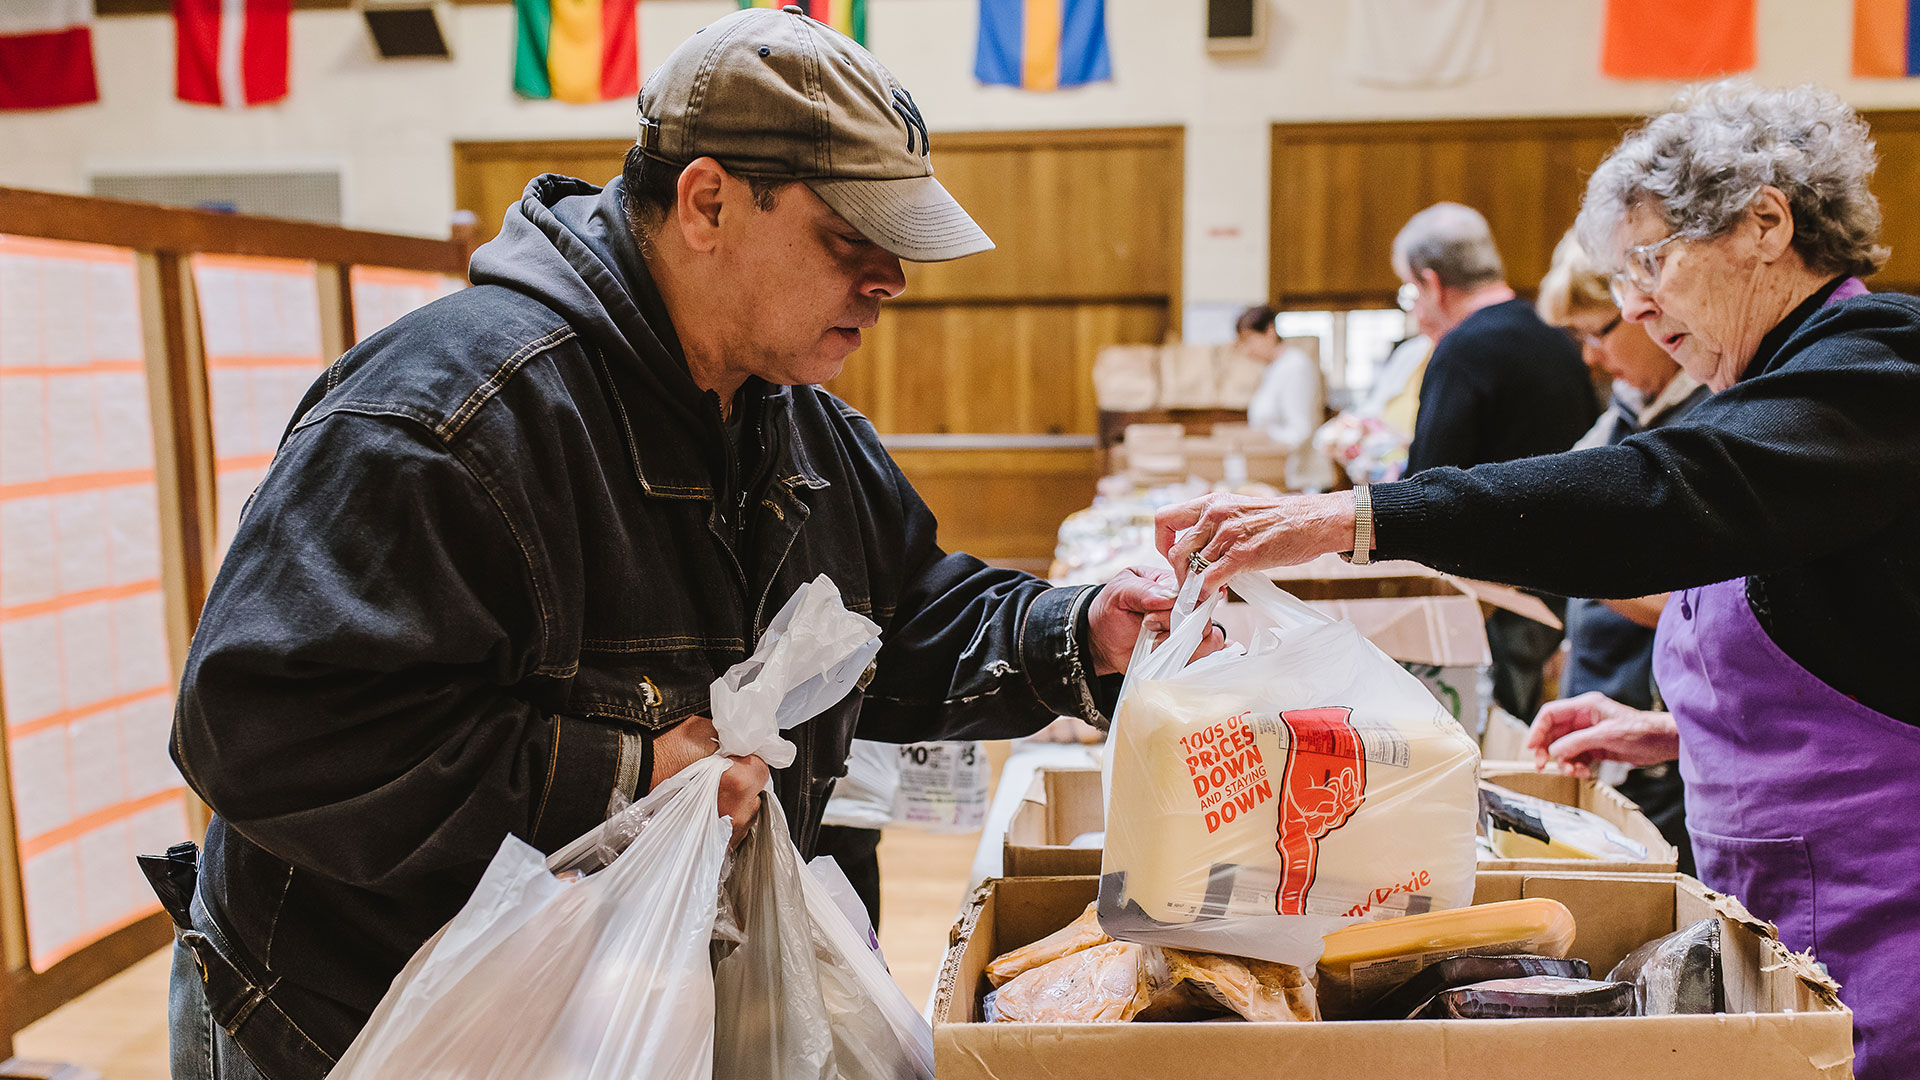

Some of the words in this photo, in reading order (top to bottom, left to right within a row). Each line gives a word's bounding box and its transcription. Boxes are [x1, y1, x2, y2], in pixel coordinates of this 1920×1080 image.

[1179, 723, 1225, 755] 100s
[1185, 724, 1255, 777] PRICES
[1192, 744, 1264, 799] DOWN
[1200, 791, 1222, 812] AND
[1224, 765, 1268, 798] STAYING
[1204, 779, 1273, 834] DOWN
[1375, 869, 1431, 905] Dixie
